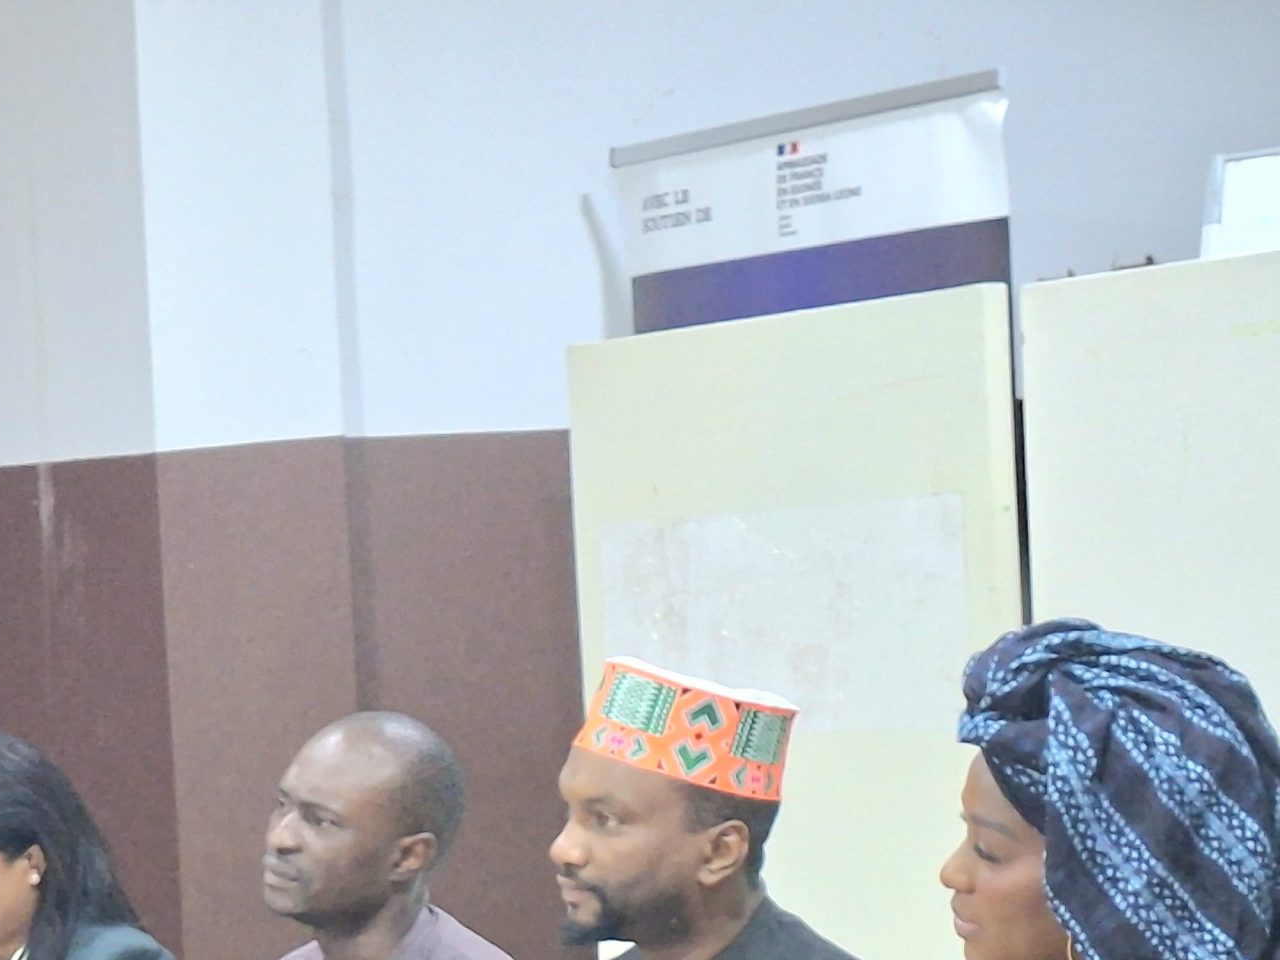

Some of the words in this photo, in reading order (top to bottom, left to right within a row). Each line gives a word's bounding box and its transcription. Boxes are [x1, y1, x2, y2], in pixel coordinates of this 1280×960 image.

[643, 192, 669, 210] AVEC
[674, 189, 689, 204] LE
[643, 212, 692, 233] SOUTIEN
[696, 207, 711, 222] DE
